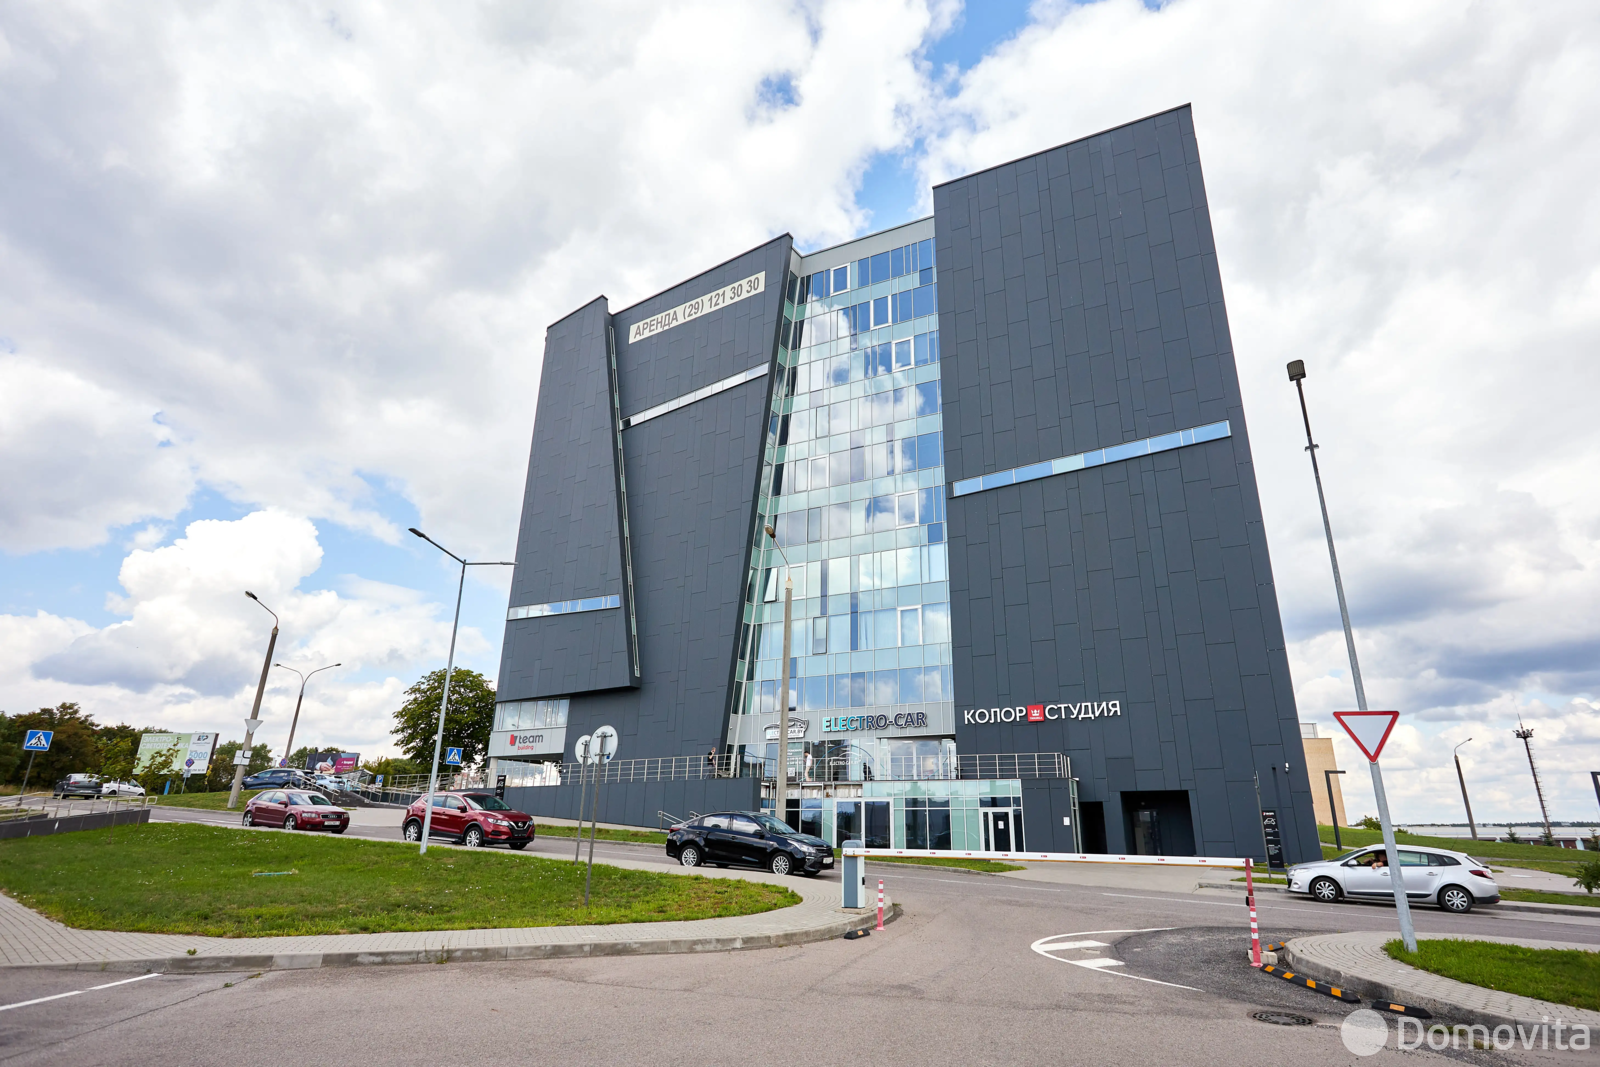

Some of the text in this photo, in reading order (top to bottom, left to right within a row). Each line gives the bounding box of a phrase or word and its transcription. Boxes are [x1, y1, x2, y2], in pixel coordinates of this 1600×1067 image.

[634, 276, 760, 339] АРЕНДА (29) 121 30 30
[822, 711, 928, 733] ELECTRO-CAR
[963, 700, 1121, 725] КОЛОР СТУДИЯ
[518, 734, 544, 744] team
